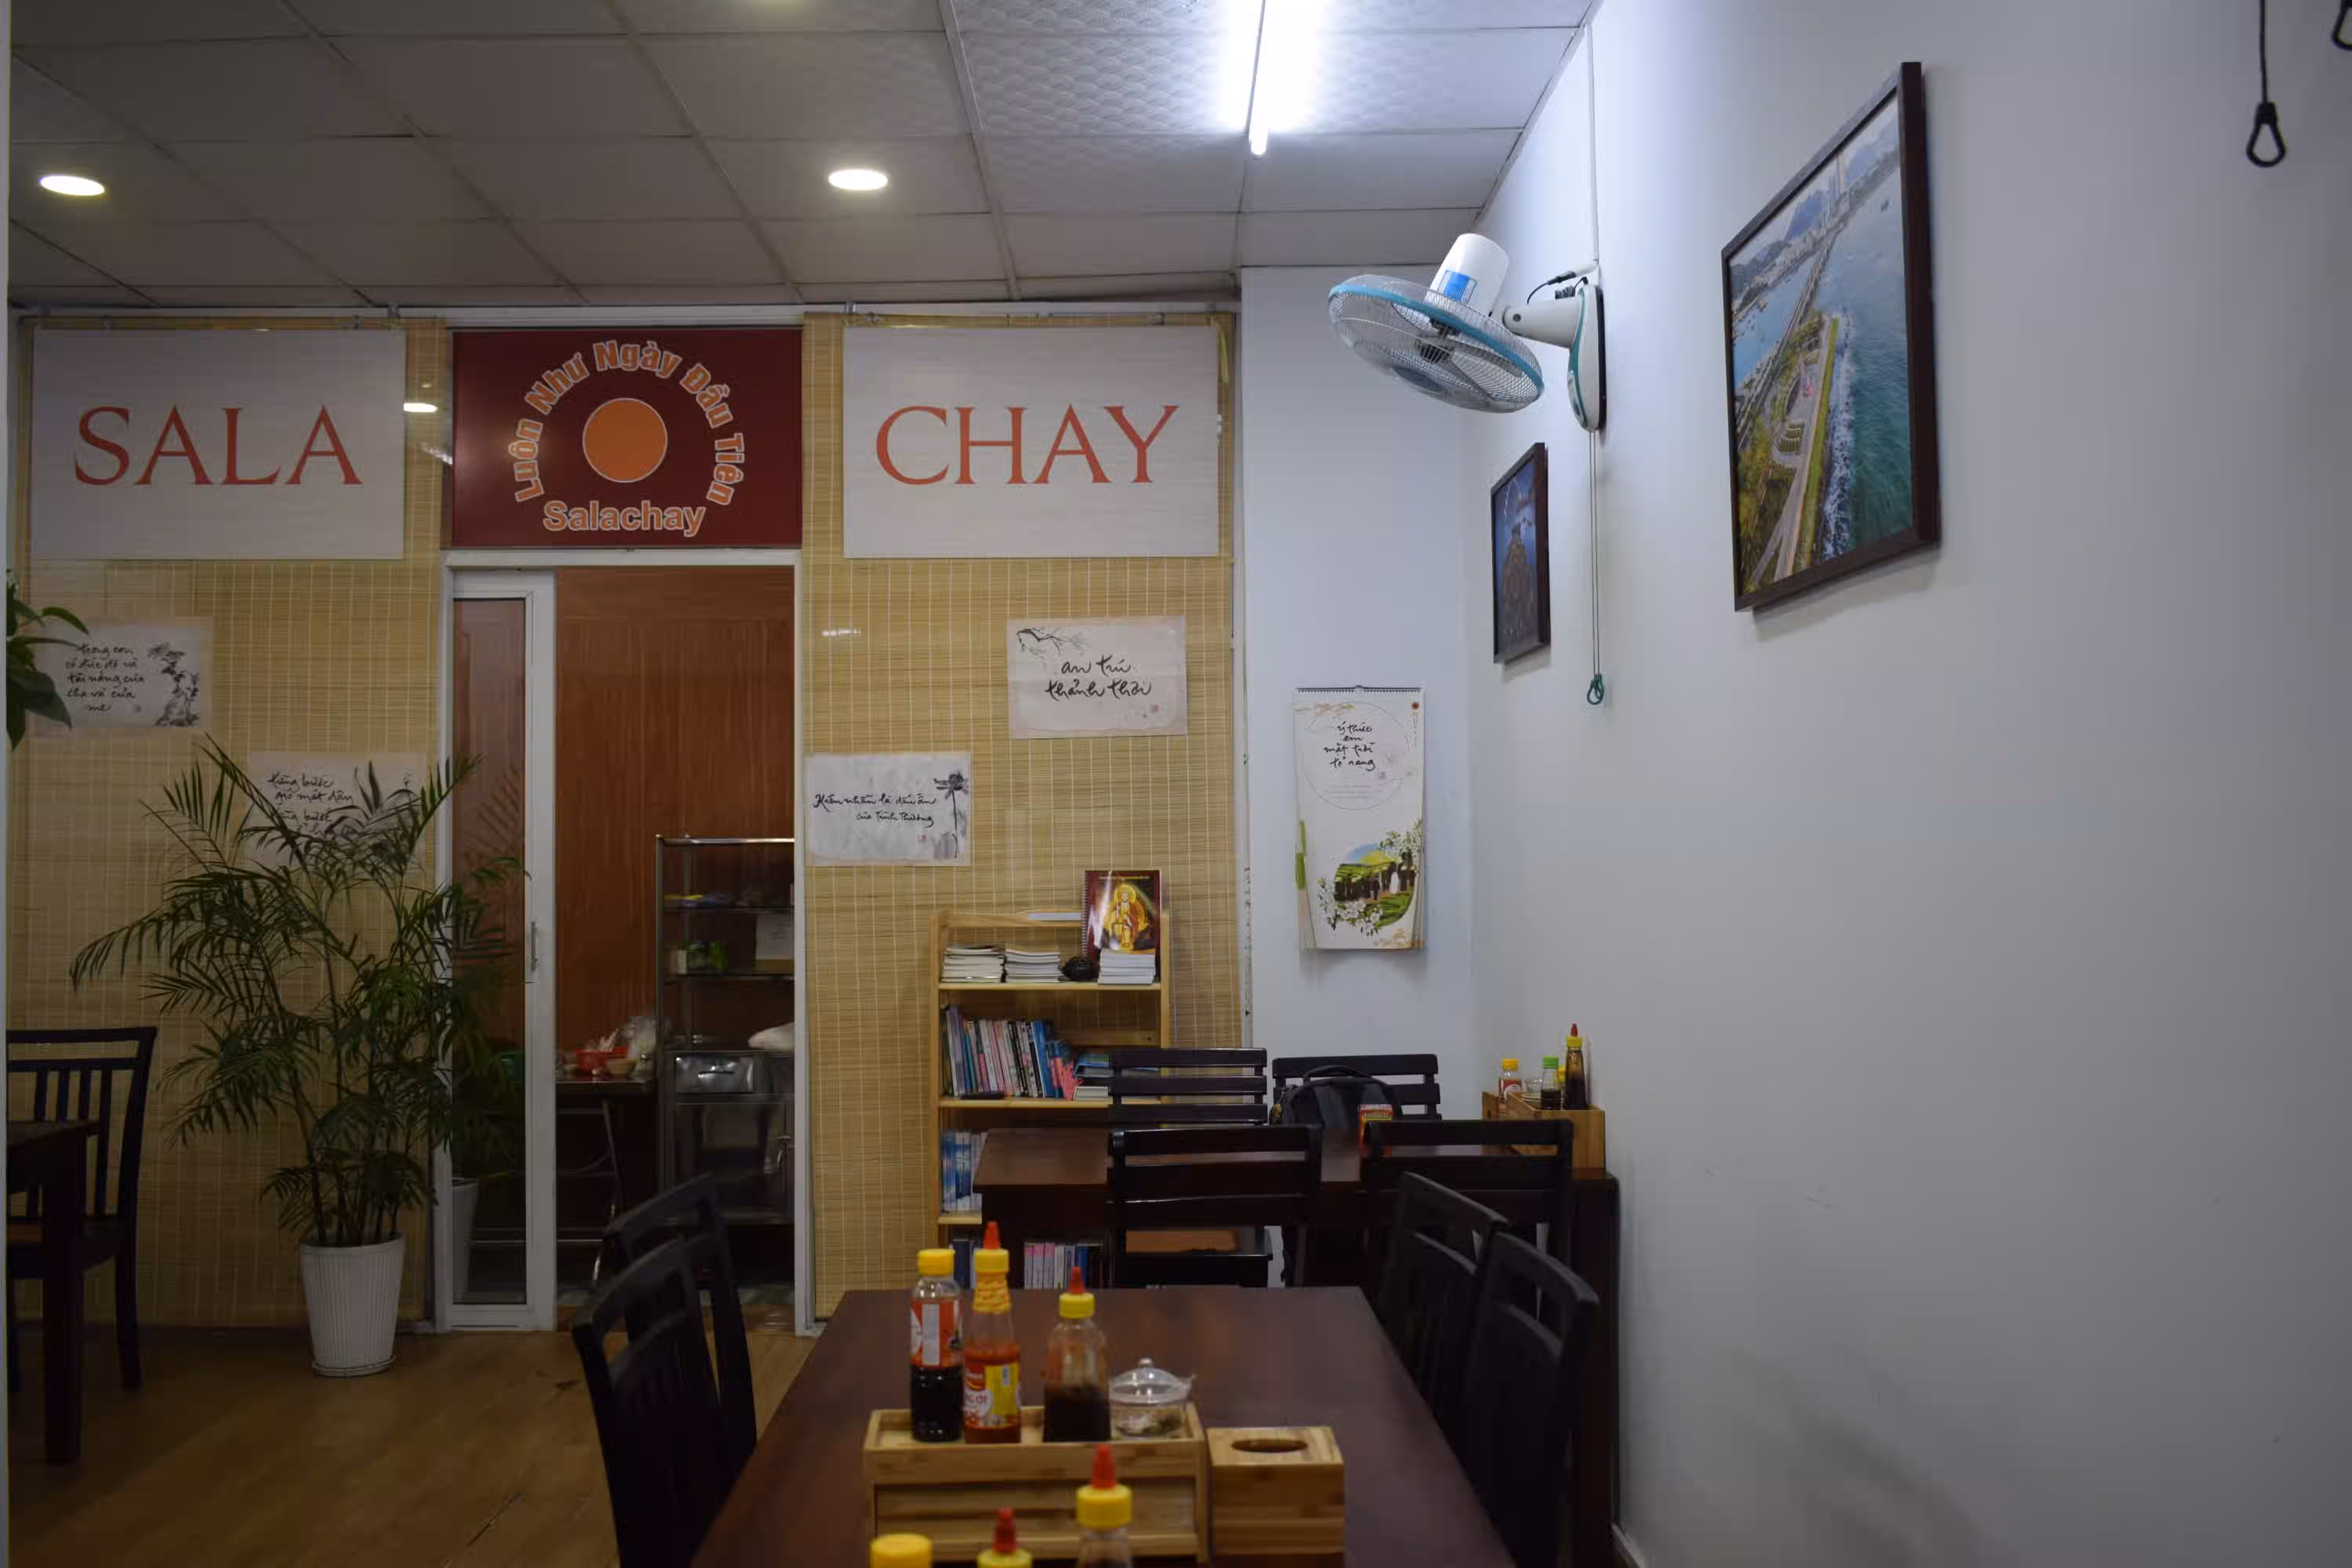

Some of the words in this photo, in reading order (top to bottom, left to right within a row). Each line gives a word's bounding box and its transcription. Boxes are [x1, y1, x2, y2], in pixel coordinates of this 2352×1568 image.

[593, 339, 682, 379] Ngày
[524, 352, 590, 414] Như
[680, 364, 733, 428] Đầu
[75, 405, 363, 485] SALA
[508, 418, 544, 502] Luôn
[876, 403, 1179, 485] CHAY
[706, 433, 744, 505] Tiên
[543, 501, 706, 537] Salachay
[1062, 661, 1091, 674] an
[67, 688, 87, 698] cha
[111, 687, 136, 698] của
[1044, 679, 1105, 702] thảnh
[1107, 679, 1152, 700] thơi
[813, 793, 843, 813] Kiên
[878, 793, 891, 805] là
[856, 812, 872, 820] của
